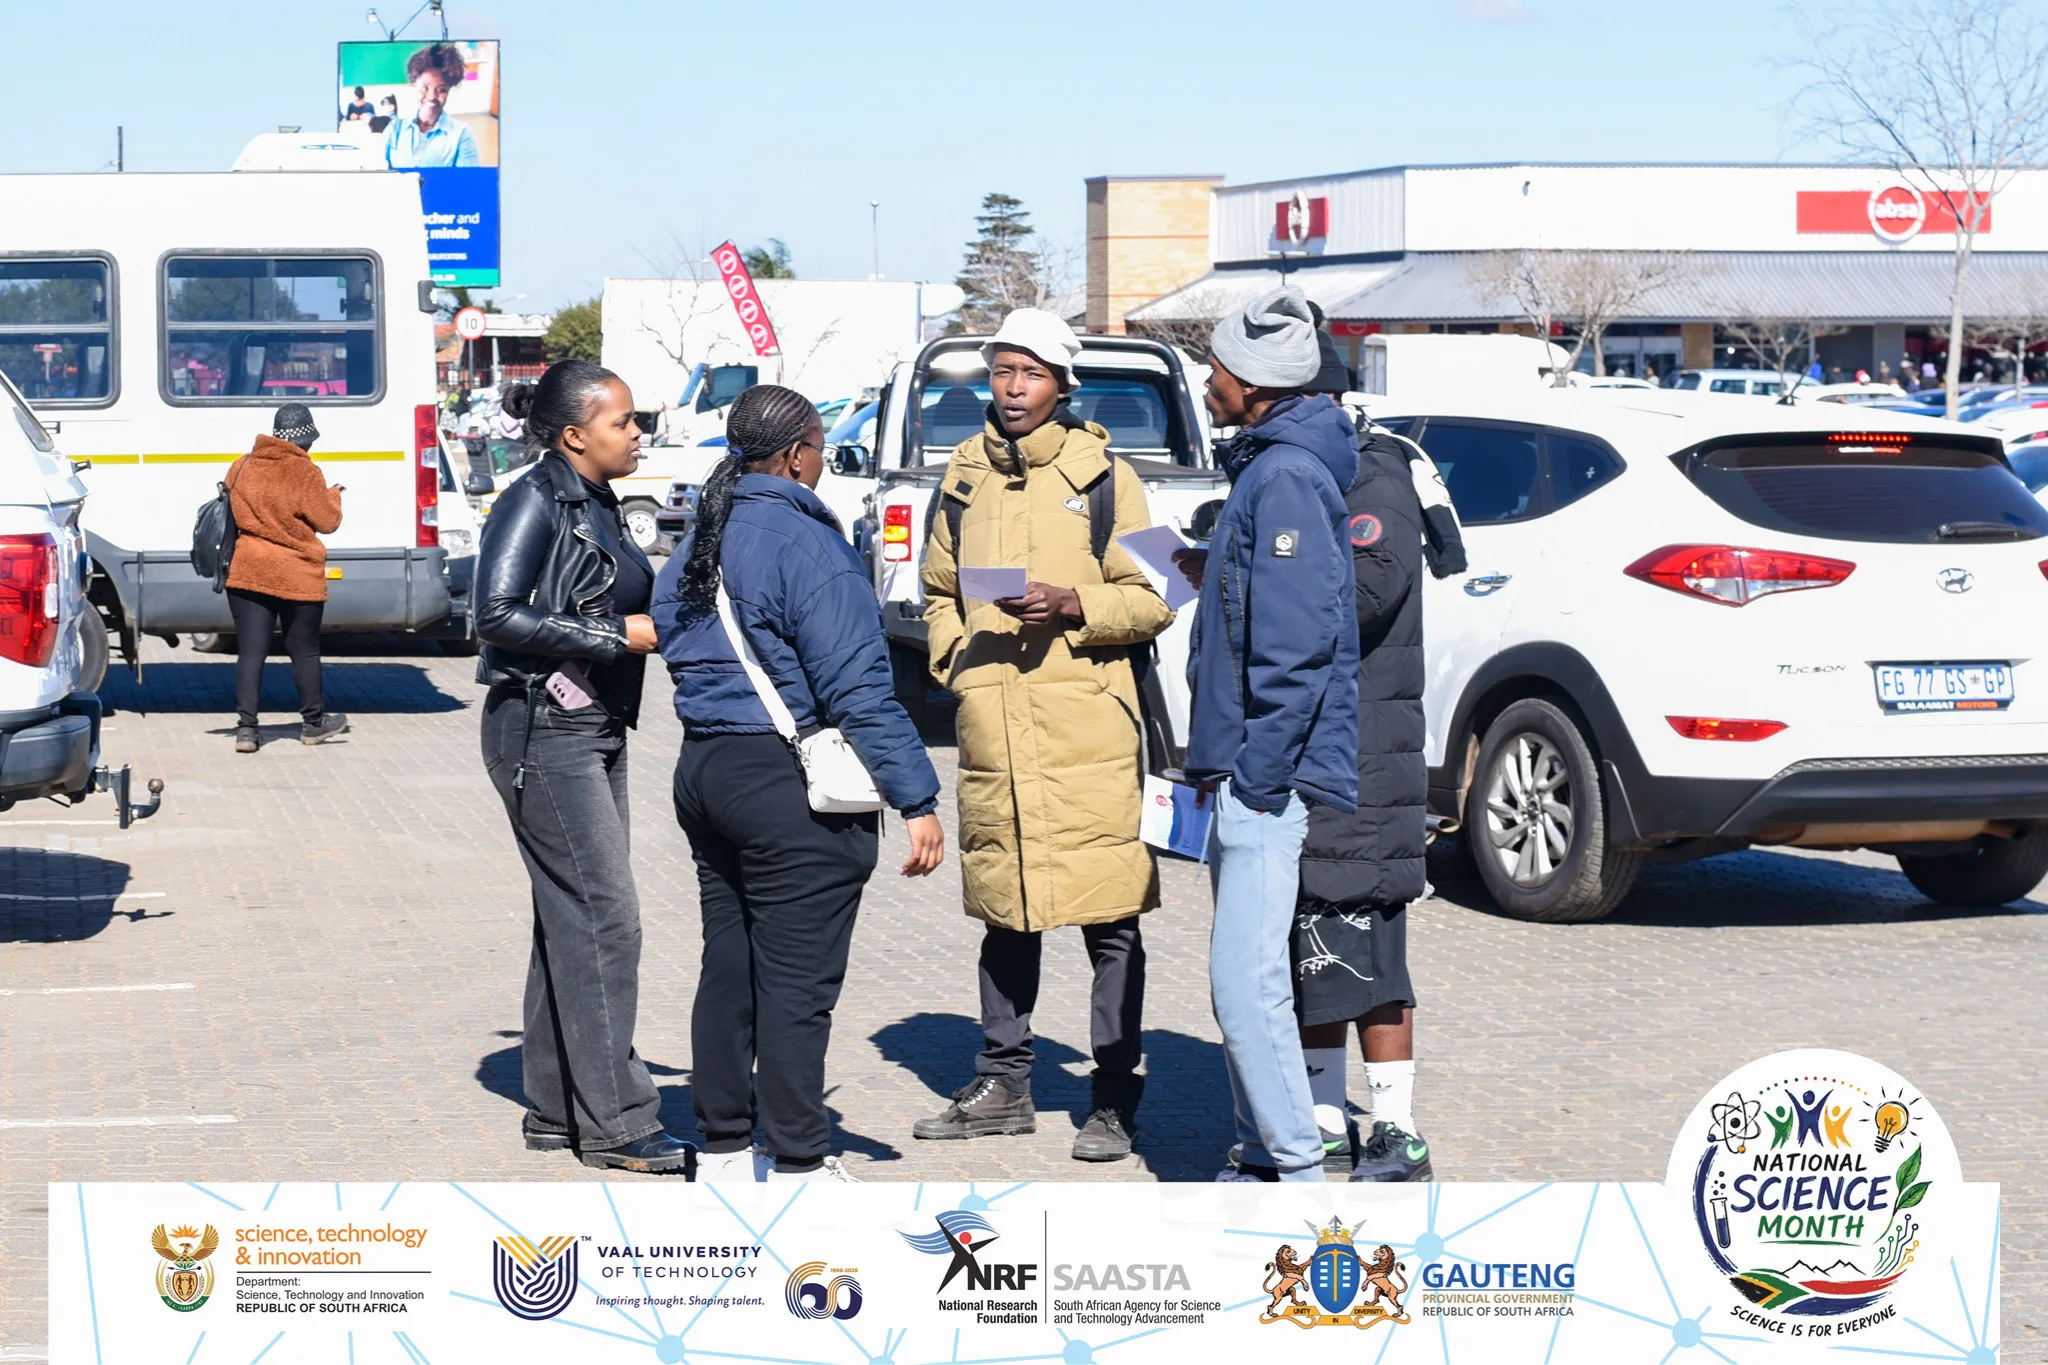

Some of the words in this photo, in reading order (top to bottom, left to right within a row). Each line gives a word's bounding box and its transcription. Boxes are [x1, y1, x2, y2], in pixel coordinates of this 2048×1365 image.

[1876, 198, 1918, 218] absa
[457, 212, 480, 224] and
[430, 227, 470, 239] minds
[464, 318, 478, 329] 10
[1777, 665, 1847, 674] TUCSON
[1882, 670, 1905, 696] FG
[1913, 669, 1934, 695] 77
[1945, 668, 1967, 695] GS
[1984, 667, 2005, 694] GP
